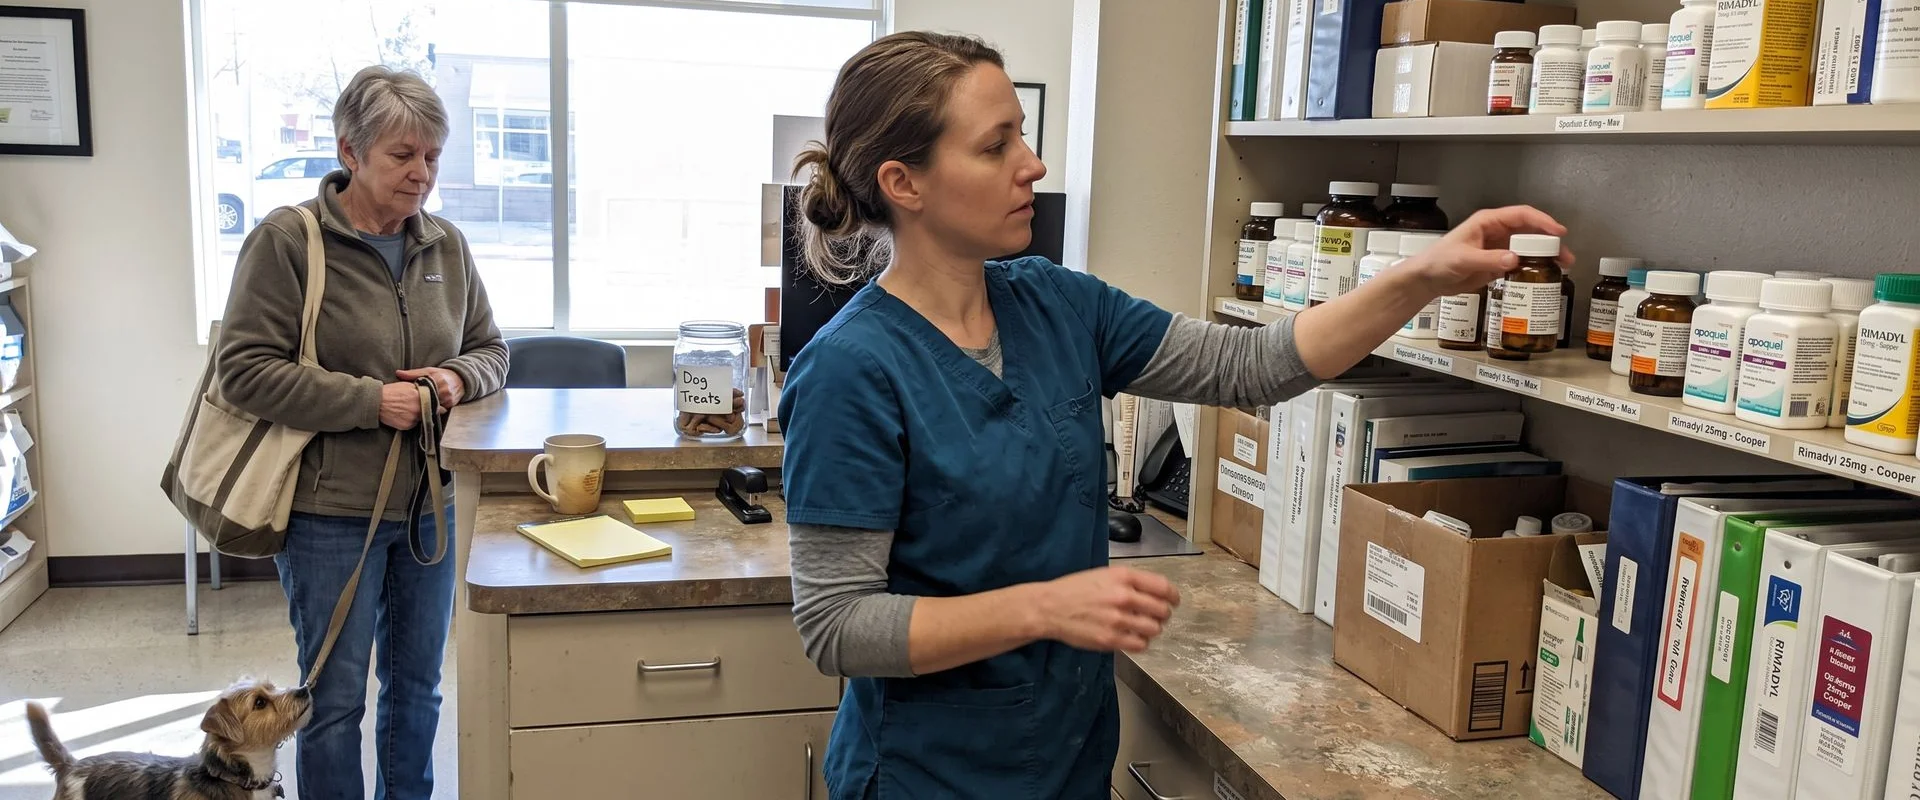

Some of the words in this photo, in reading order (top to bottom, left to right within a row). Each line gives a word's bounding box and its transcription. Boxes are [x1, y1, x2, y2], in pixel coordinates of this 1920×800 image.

[1718, 0, 1759, 10] RIMADYL
[1694, 328, 1728, 340] apoquel
[1861, 328, 1908, 344] RIMADYL
[1748, 338, 1784, 350] apoquel
[683, 370, 708, 390] Dog
[1479, 368, 1501, 382] Rimadyl
[1502, 374, 1520, 387] 3.5mg
[1524, 380, 1538, 390] Max
[680, 390, 721, 404] Treats
[1568, 390, 1596, 406] Rimadyl
[1596, 398, 1615, 412] 25mg
[1620, 404, 1637, 416] Max
[1672, 416, 1704, 433] Rimadyl
[1704, 424, 1728, 440] 25mg
[1734, 432, 1766, 448] Cooper
[1798, 446, 1838, 466] Rimadyl
[1839, 456, 1867, 474] 25mg
[1876, 466, 1917, 484] Cooper
[1768, 638, 1785, 698] RIMADYL
[1823, 692, 1852, 710] Cooper
